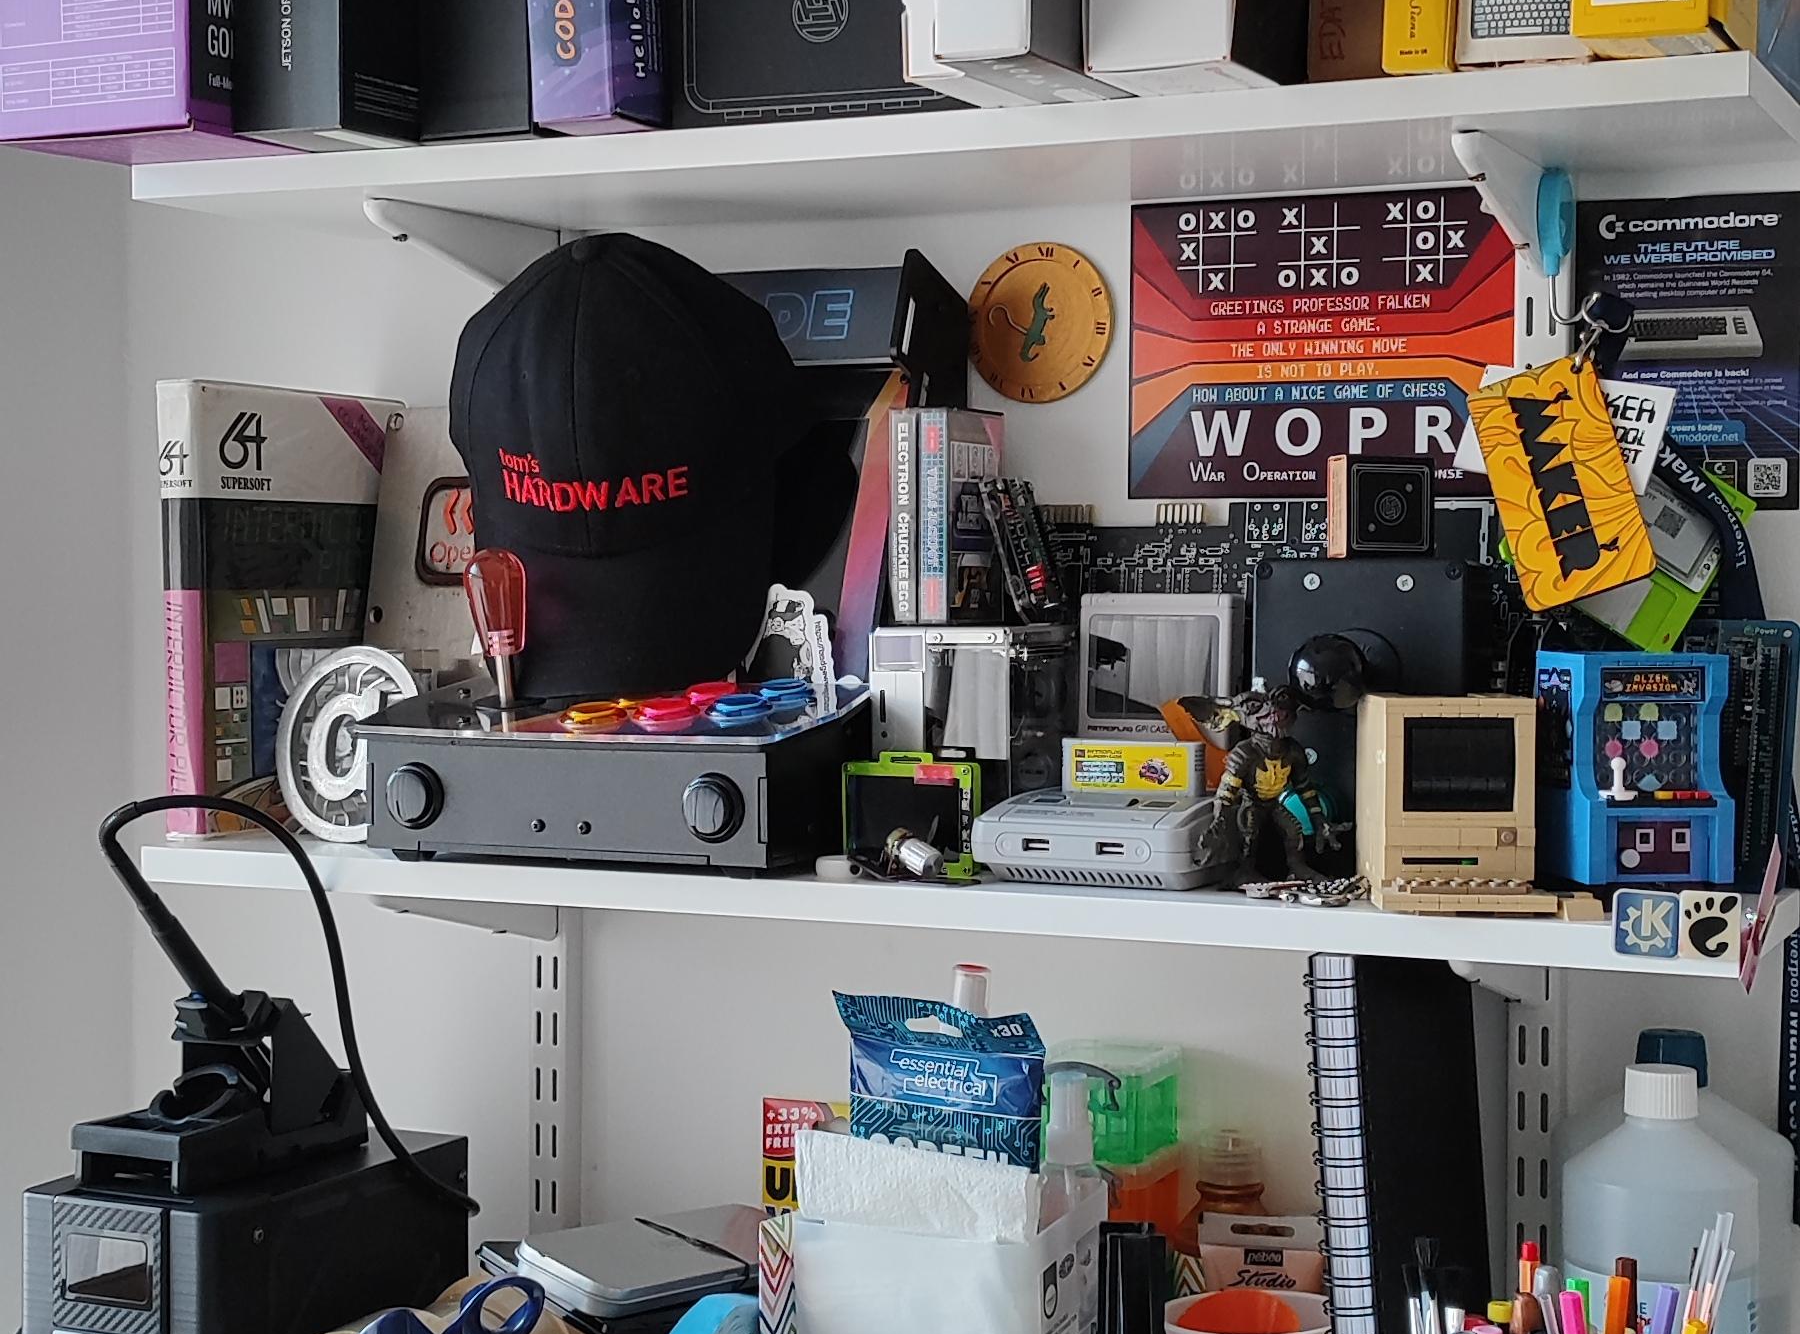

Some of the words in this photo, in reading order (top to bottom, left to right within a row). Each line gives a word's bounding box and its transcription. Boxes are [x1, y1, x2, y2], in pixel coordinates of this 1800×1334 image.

[281, 17, 292, 71] JETSON
[1637, 242, 1671, 253] THE
[1673, 239, 1740, 252] FUTURE
[1604, 254, 1631, 265] WE
[1633, 251, 1683, 264] WERE
[1685, 249, 1776, 263] PROMISED
[1633, 272, 1673, 280] Commodore
[1210, 299, 1285, 316] GREETINGS
[1292, 296, 1370, 314] PROFESSOR
[1377, 294, 1431, 310] FALKEN
[1256, 322, 1266, 335] A
[1273, 319, 1333, 336] STRANGE
[1340, 317, 1381, 333] GAME.
[1230, 342, 1255, 358] THE
[1262, 340, 1297, 356] ONLY
[1303, 339, 1364, 355] WINNING
[1371, 337, 1408, 354] MOVE
[1256, 365, 1272, 380] IS
[1280, 364, 1306, 379] NOT
[1315, 363, 1331, 378] TO
[1339, 362, 1380, 377] PLAY.
[1622, 371, 1638, 379] And
[1660, 369, 1713, 379] Commodore
[1725, 368, 1750, 377] back!
[1192, 387, 1218, 404] HOW
[1225, 386, 1268, 403] ABOUT
[1274, 385, 1285, 401] A
[1291, 384, 1326, 401] NICE
[1333, 383, 1369, 400] GAME
[1377, 383, 1393, 399] OF
[1402, 381, 1447, 398] CHESS
[1698, 423, 1723, 432] today
[219, 412, 268, 471] 64
[498, 448, 540, 474] tom's
[897, 421, 910, 507] ELECTRON
[220, 476, 272, 491] SUPERSOFT
[501, 466, 689, 513] HARDWARE
[1708, 492, 1748, 569] Liverpool
[898, 511, 910, 579] CHUCKIE
[899, 580, 911, 613] EGG
[1754, 626, 1779, 636] Power
[1624, 683, 1679, 693] INVASION
[1633, 673, 1669, 684] ALIEN
[989, 1023, 1024, 1038] x30
[899, 1055, 969, 1079] essential
[914, 1073, 986, 1097] electrical
[767, 1107, 817, 1123] +33%
[1227, 1268, 1297, 1289] Studio
